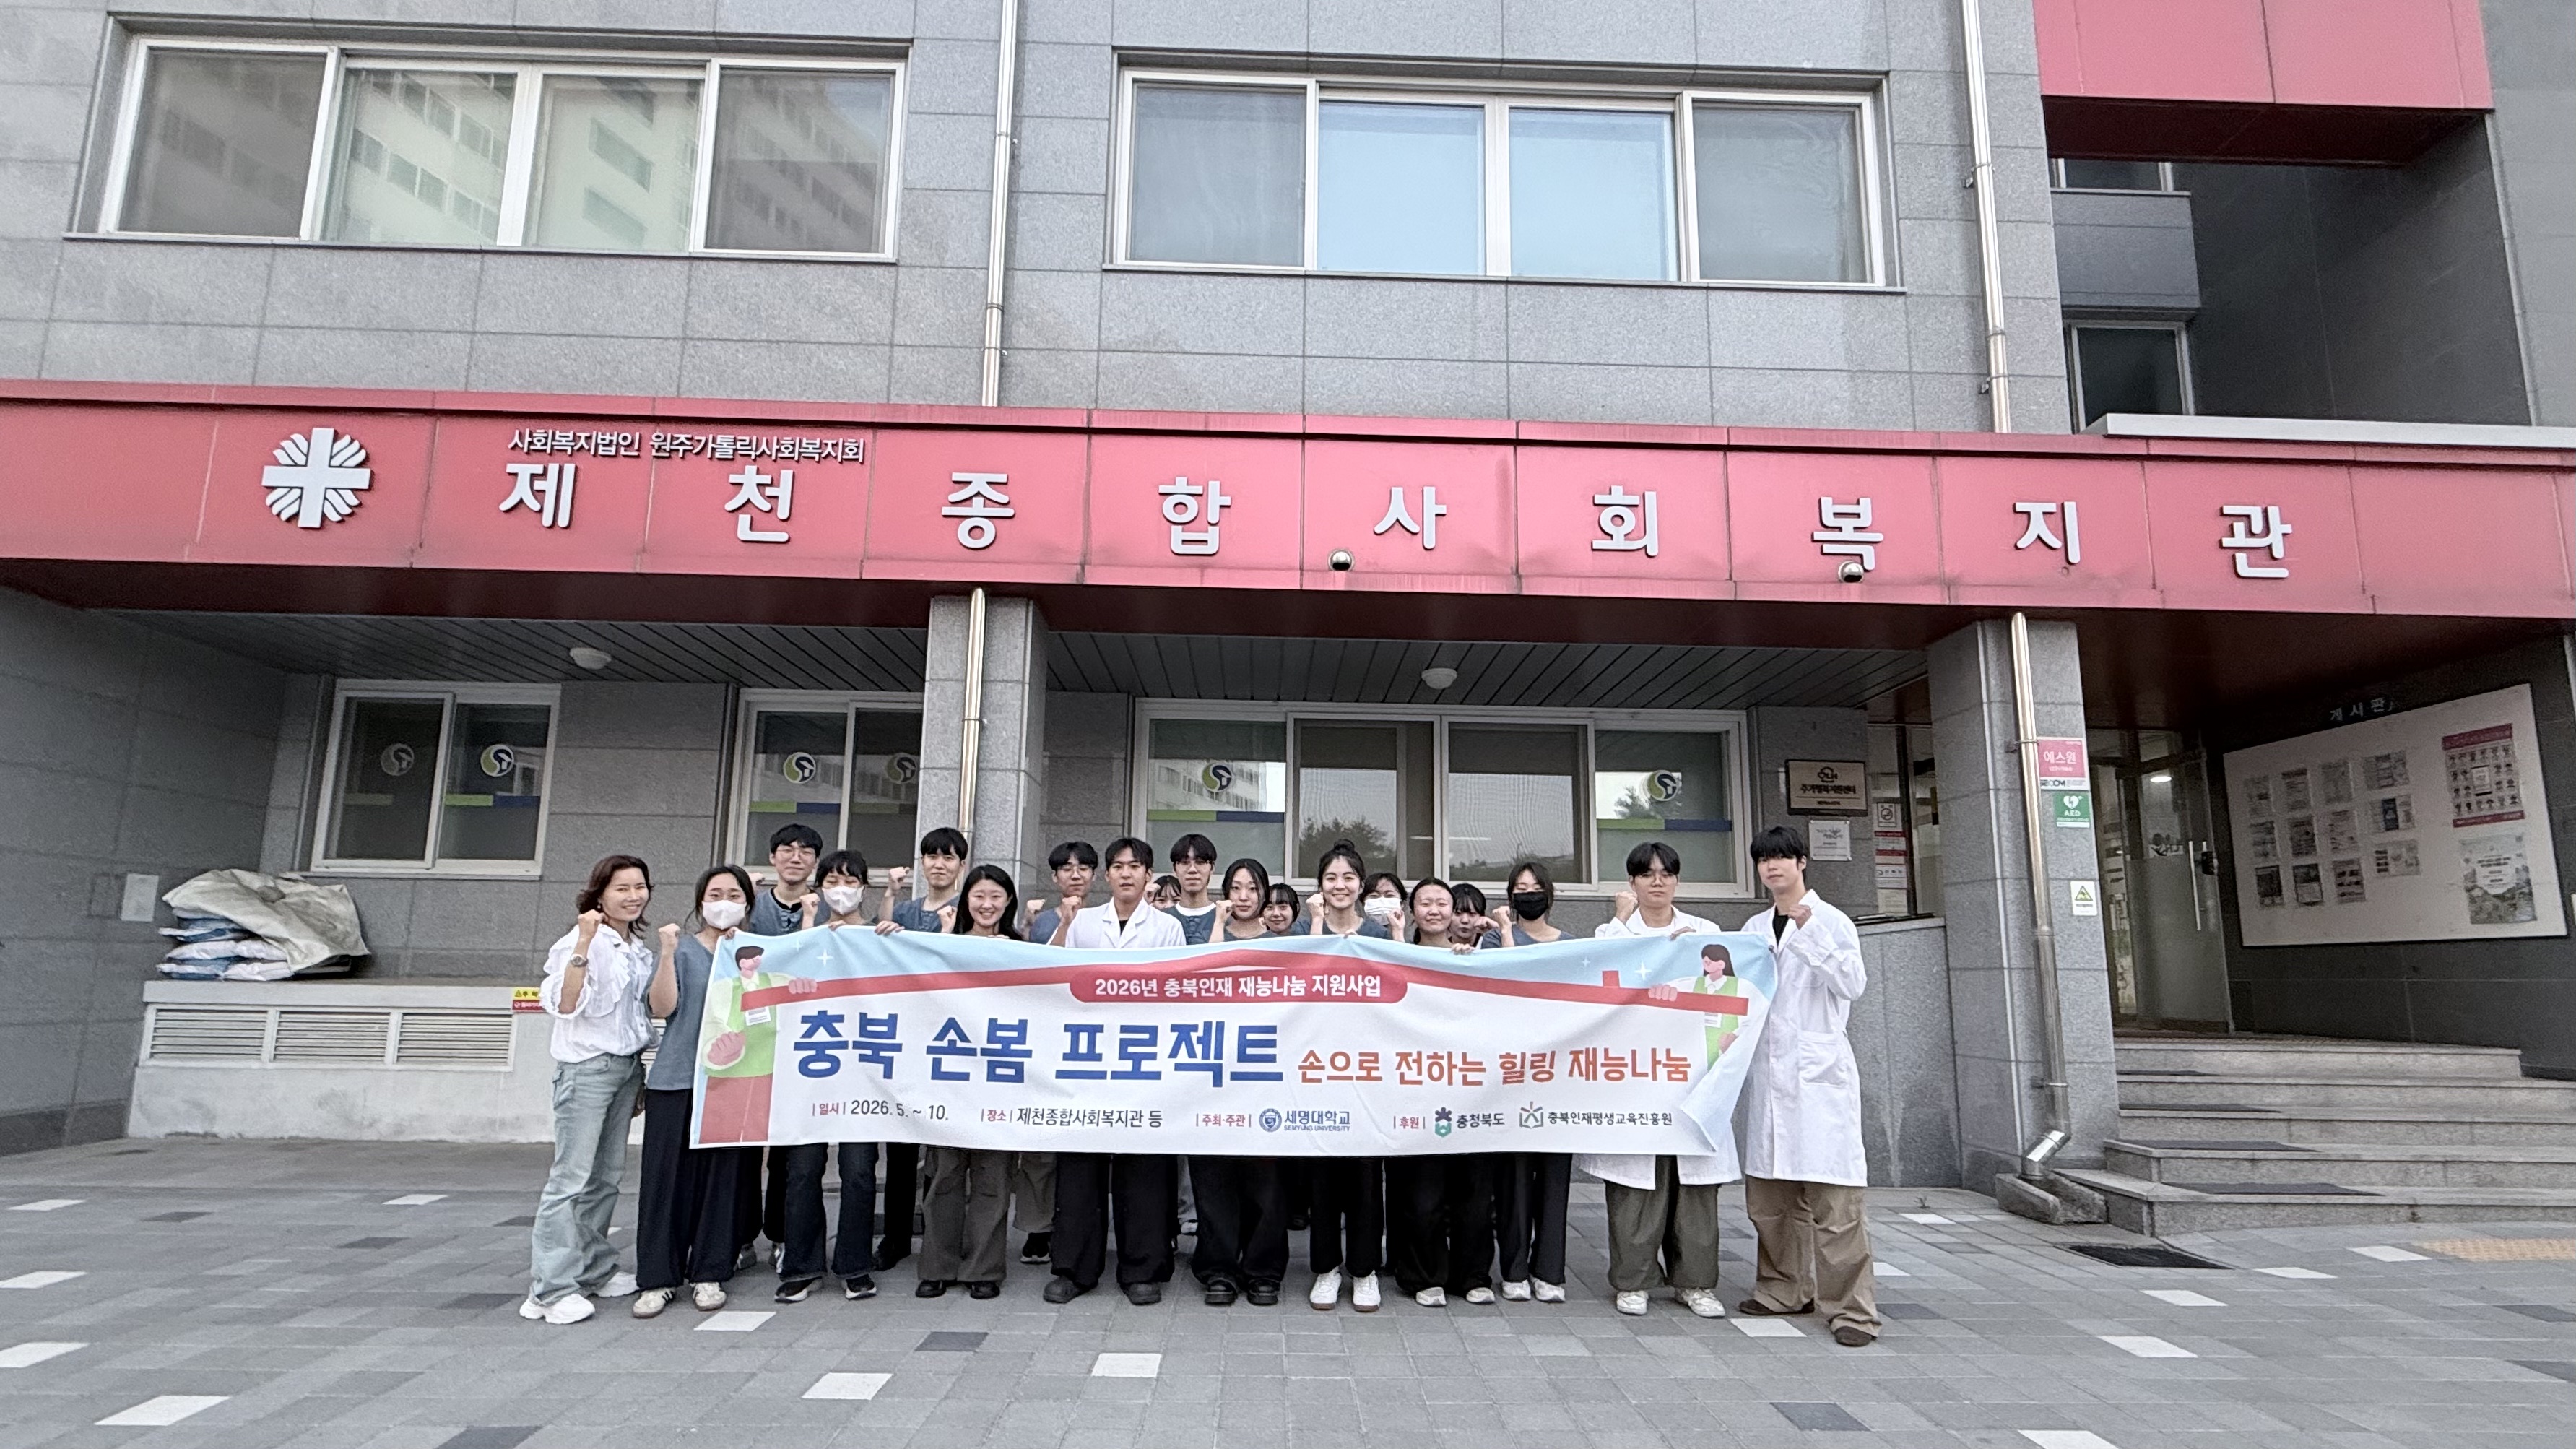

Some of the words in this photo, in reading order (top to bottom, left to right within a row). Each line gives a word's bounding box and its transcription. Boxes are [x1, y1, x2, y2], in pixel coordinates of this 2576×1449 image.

[507, 428, 641, 457] 사회복지법인
[649, 431, 864, 462] 원주가톨릭사회복지회
[499, 462, 2291, 579] 제천종합사회복지관
[2043, 751, 2077, 765] 에스원
[1095, 978, 1158, 998] 2026년
[1163, 977, 1232, 998] 충북인재
[1238, 976, 1306, 997] 재능나눔
[1311, 974, 1381, 997] 지원사업
[794, 1010, 903, 1079] 충북
[926, 1017, 1033, 1083] 손봄
[1055, 1021, 1283, 1088] 프로젝트
[1298, 1050, 1382, 1083] 손으로
[1395, 1050, 1486, 1086] 전하는
[1499, 1050, 1556, 1085] 힐링
[1568, 1047, 1691, 1082] 재능나눔
[851, 1099, 893, 1115] 2026.
[896, 1103, 908, 1117] 5.
[928, 1104, 949, 1120] 10.
[1016, 1107, 1144, 1128] 제천종합사회복지관
[1148, 1110, 1163, 1128] 등
[1284, 1110, 1350, 1125] 세명대학교
[1548, 1111, 1673, 1126] 충북인재평생교육진흥원
[1456, 1112, 1505, 1129] 충청북도
